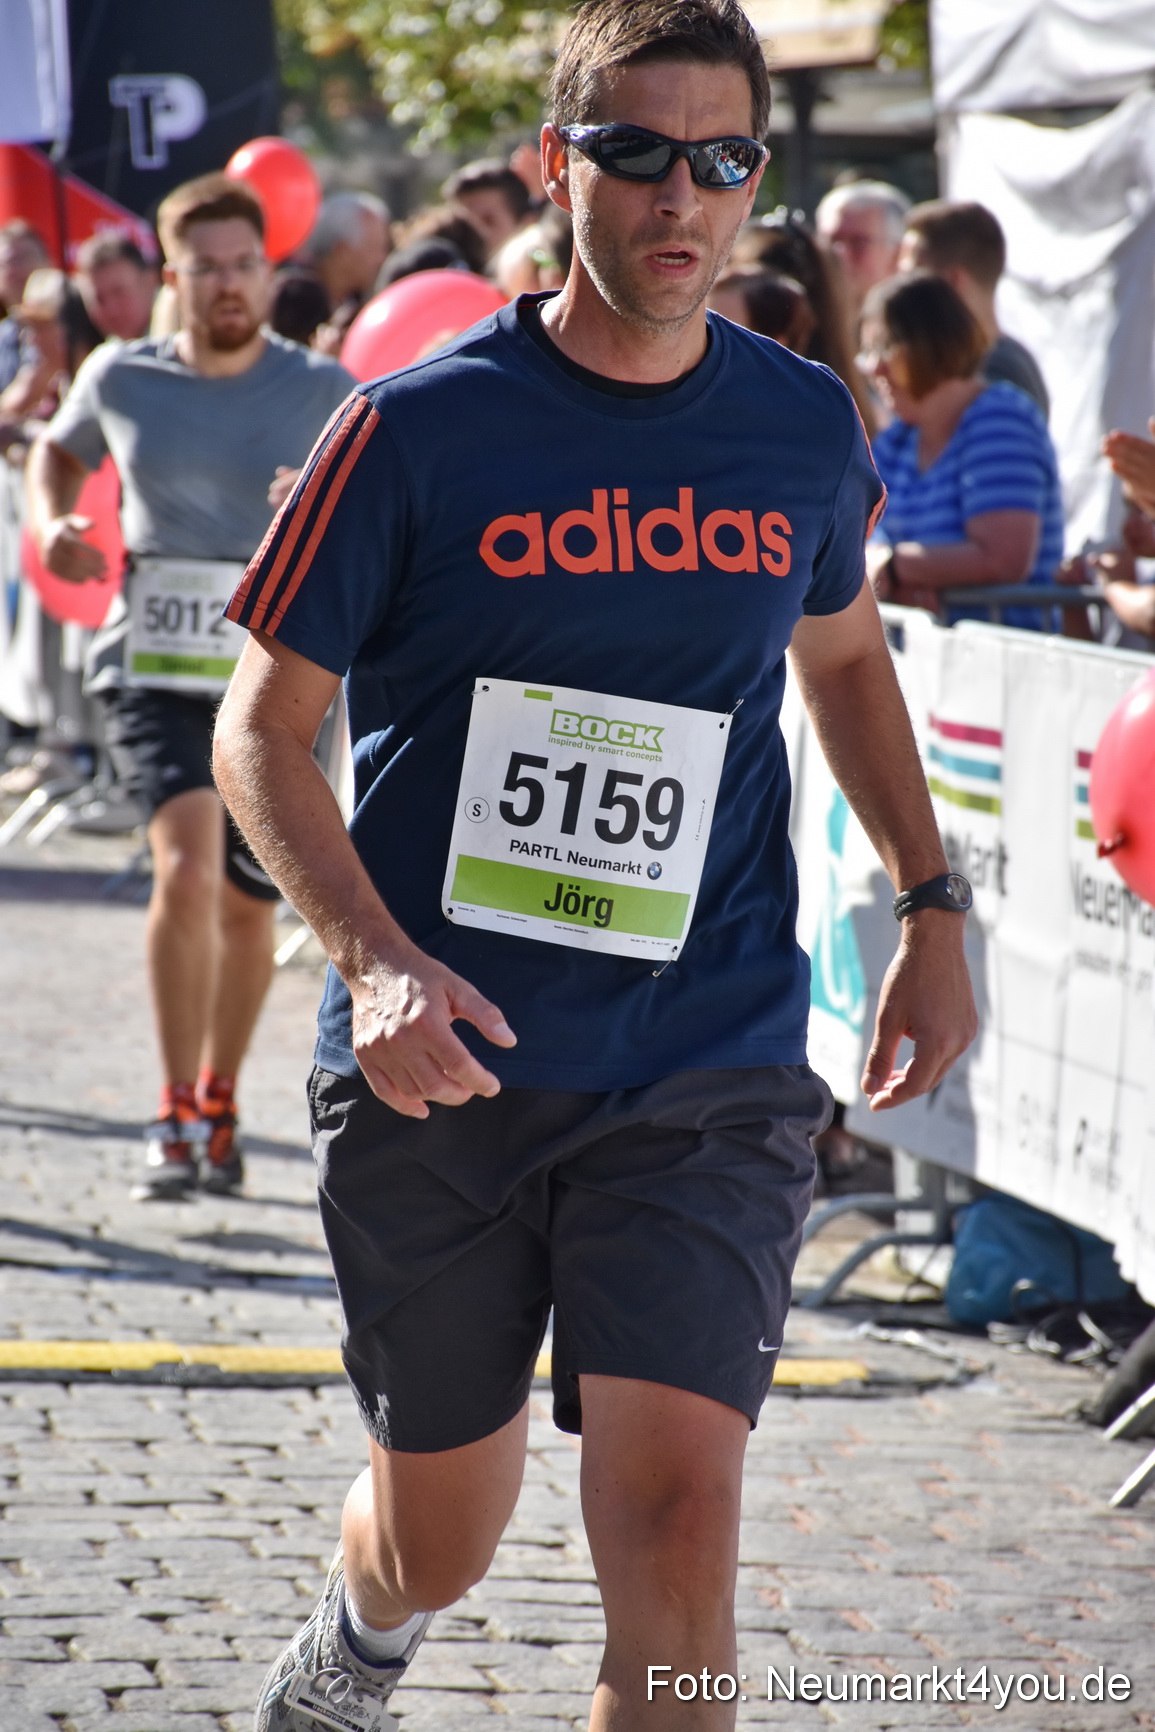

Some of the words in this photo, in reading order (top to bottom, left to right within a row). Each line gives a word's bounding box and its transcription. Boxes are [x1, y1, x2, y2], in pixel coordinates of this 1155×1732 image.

[479, 487, 793, 578] adidas
[144, 596, 229, 638] 5012
[548, 735, 583, 749] inspired
[585, 742, 597, 753] by
[598, 746, 625, 757] smart
[626, 750, 663, 762] concepts
[550, 708, 666, 753] BOCK
[472, 803, 482, 817] S
[499, 751, 685, 852] 5159
[509, 839, 563, 863] PARTL
[566, 851, 642, 876] Neumarkt
[543, 882, 615, 928] Jörg
